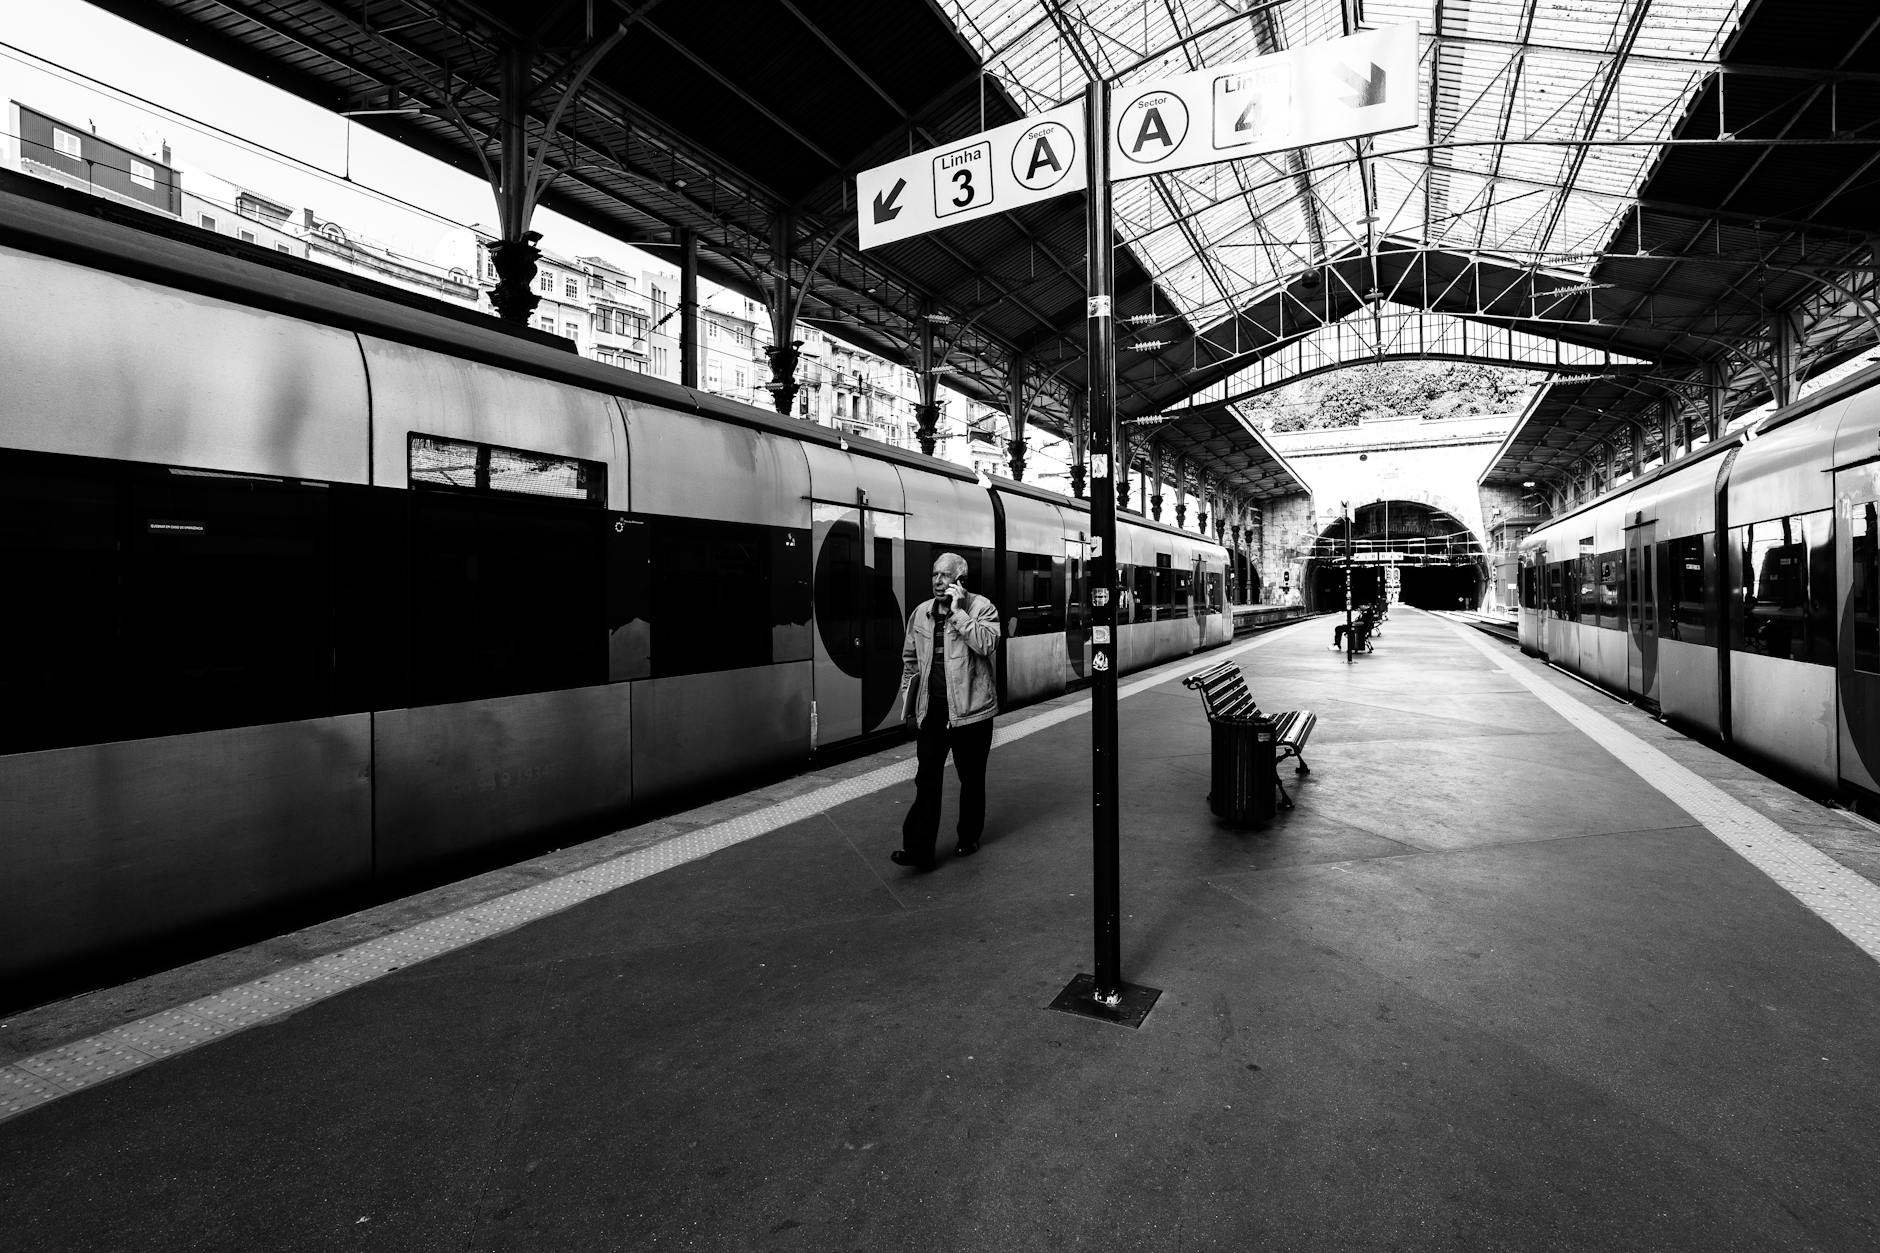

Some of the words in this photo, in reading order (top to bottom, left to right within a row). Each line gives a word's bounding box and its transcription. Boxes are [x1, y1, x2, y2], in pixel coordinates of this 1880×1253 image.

[1138, 97, 1167, 109] Sector
[1028, 127, 1055, 140] Sector
[1132, 107, 1173, 153] A
[942, 149, 981, 169] Linha
[1026, 136, 1062, 180] A
[952, 169, 975, 207] 3
